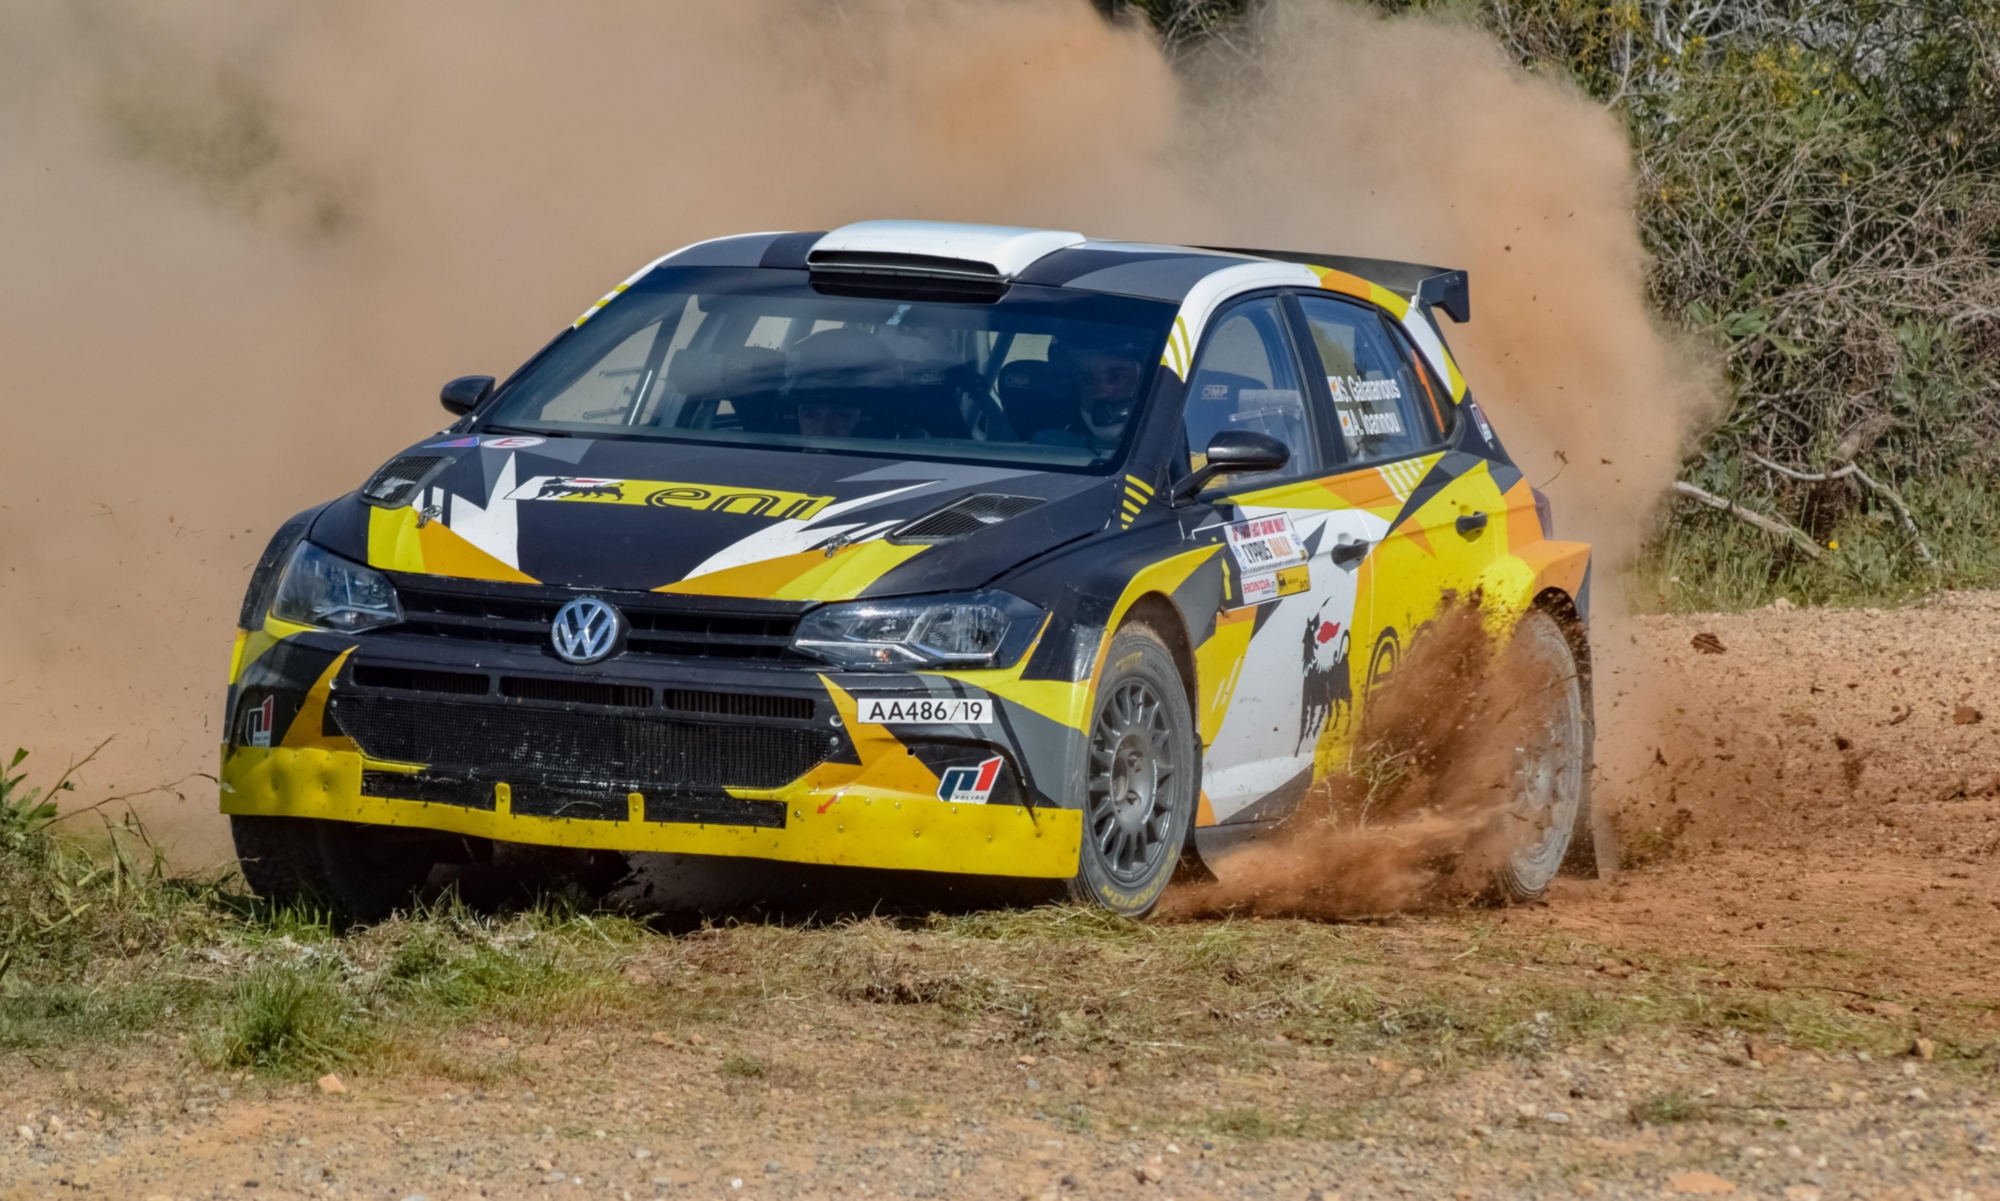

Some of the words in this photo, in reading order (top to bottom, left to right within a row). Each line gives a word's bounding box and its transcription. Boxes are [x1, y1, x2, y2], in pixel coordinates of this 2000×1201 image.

[1202, 386, 1228, 397] OMP
[1337, 376, 1352, 402] S.
[1349, 408, 1365, 436] A.
[1358, 408, 1401, 435] Ioannou
[493, 437, 535, 446] E
[644, 487, 834, 521] eni
[1241, 540, 1273, 564] CYPRUS
[1243, 579, 1271, 594] HONDA
[869, 701, 983, 721] AA486/19
[1101, 843, 1177, 909] SCORPION
